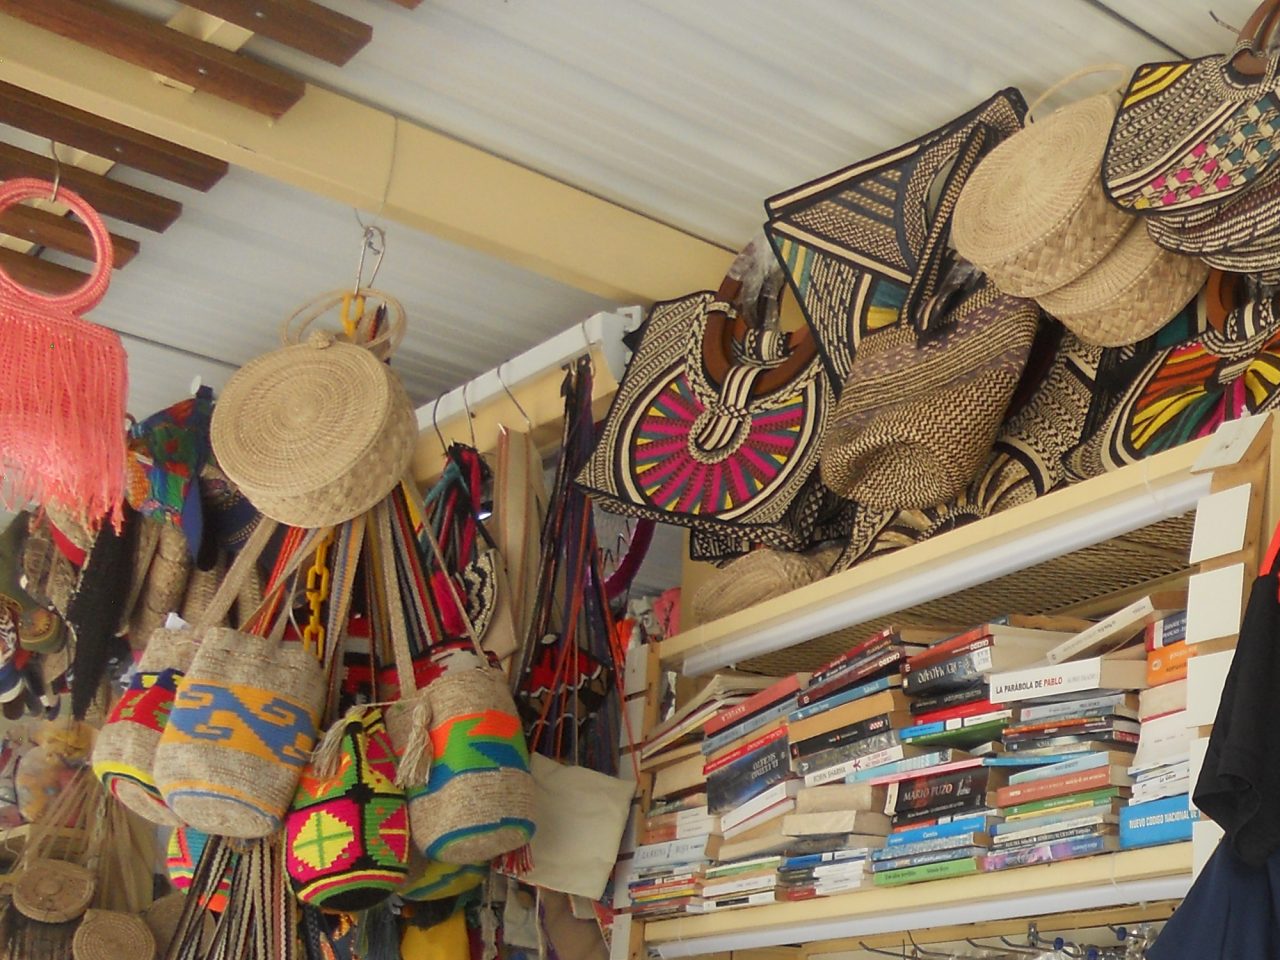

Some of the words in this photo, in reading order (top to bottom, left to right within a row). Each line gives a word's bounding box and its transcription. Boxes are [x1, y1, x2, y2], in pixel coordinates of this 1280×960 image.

[995, 686, 1003, 695] LA
[1004, 680, 1034, 693] PARÁBOLA
[1034, 680, 1043, 688] DE
[1043, 676, 1063, 687] PABLO
[903, 786, 929, 802] MARIO
[929, 783, 953, 797] PUZO
